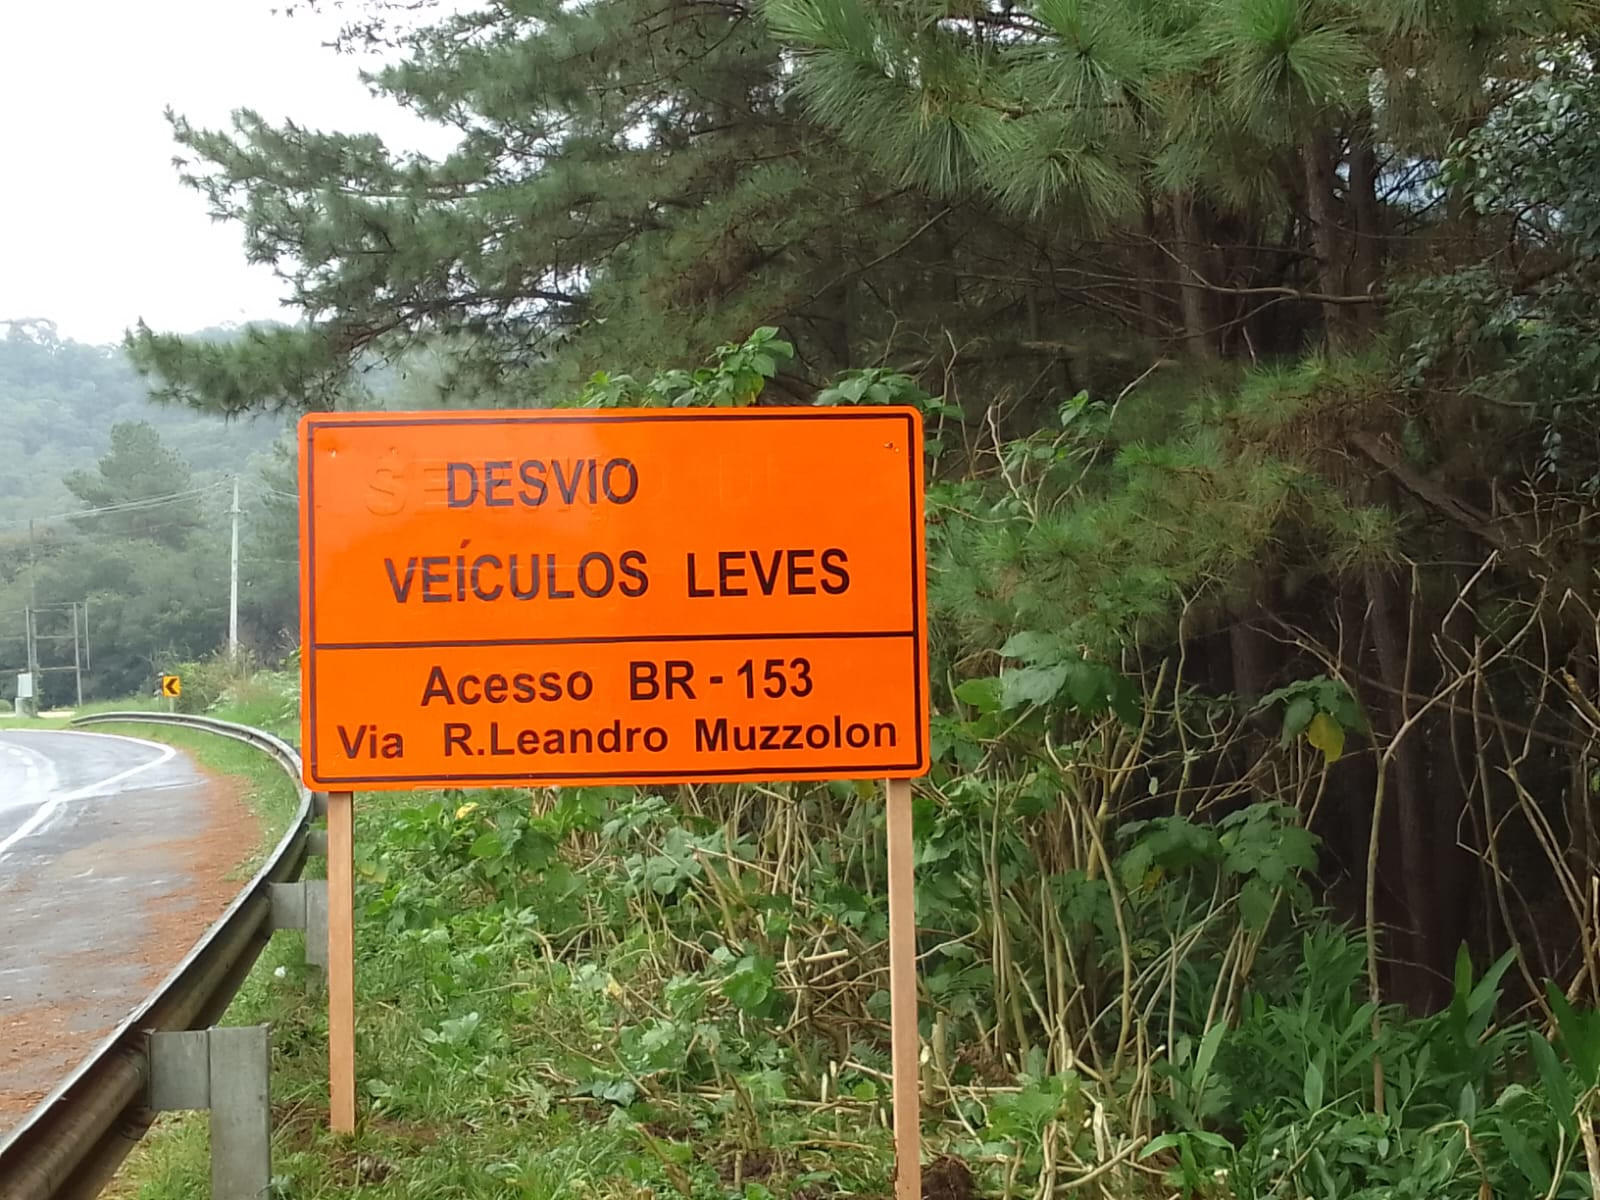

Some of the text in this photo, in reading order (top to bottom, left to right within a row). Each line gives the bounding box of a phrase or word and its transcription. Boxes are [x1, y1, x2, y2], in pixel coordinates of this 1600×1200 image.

[447, 458, 639, 508] DESVIO
[385, 538, 850, 604] VEÍCULOS LEVES
[421, 665, 593, 707] Acesso
[337, 725, 403, 759] Via
[695, 716, 897, 752] Muzzolon
